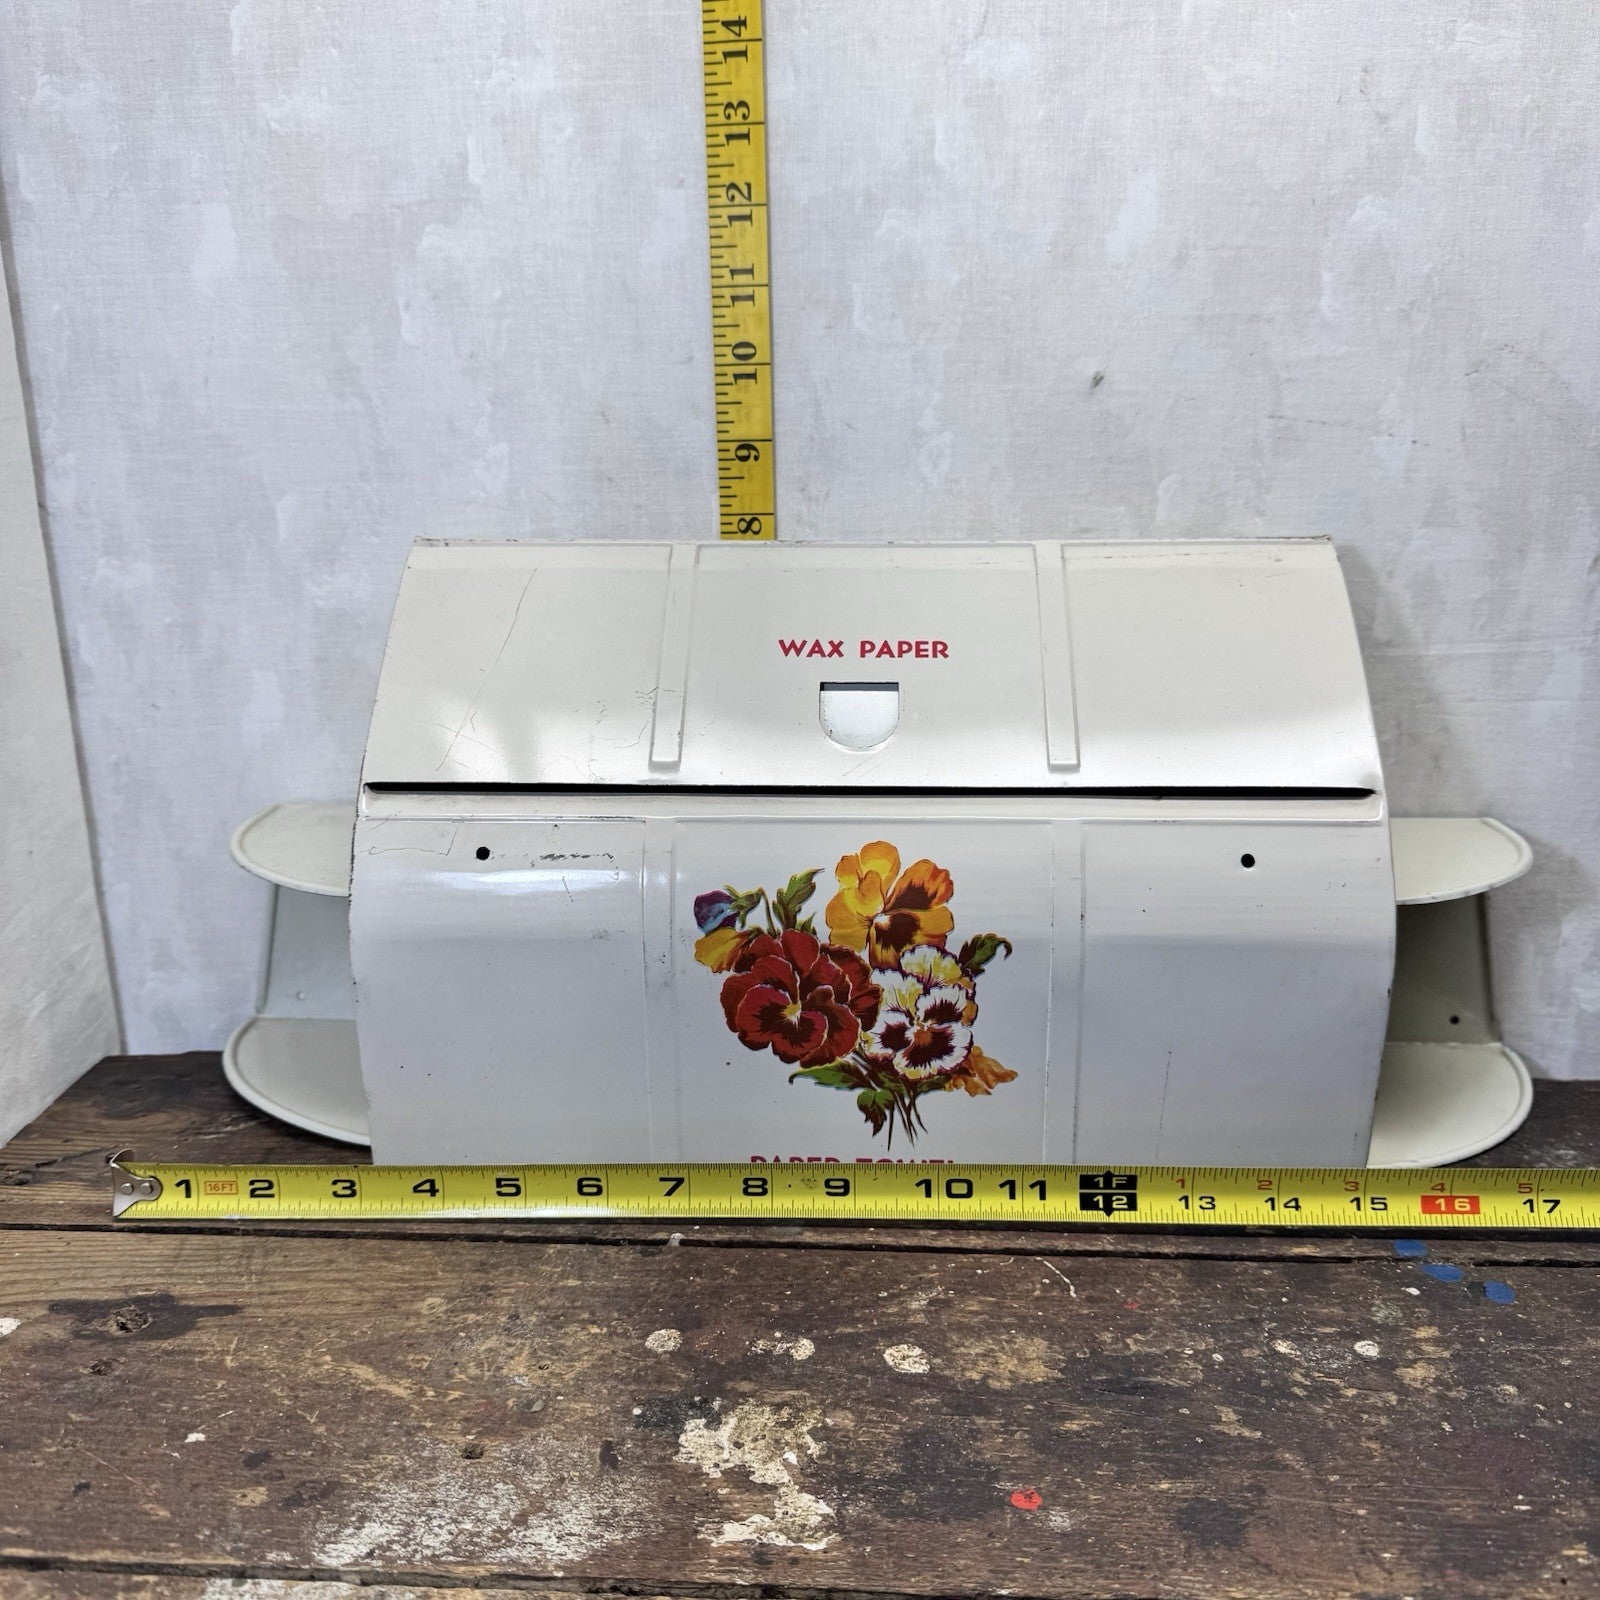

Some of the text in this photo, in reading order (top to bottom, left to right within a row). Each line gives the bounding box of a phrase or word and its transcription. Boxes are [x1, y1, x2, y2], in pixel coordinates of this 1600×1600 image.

[721, 15, 762, 535] 8 9 10 11 12 13 14
[778, 639, 950, 659] WAX PAPER
[174, 1179, 192, 1199] 1
[248, 1179, 276, 1198] 2
[331, 1179, 357, 1198] 3
[412, 1178, 440, 1198] 4
[495, 1177, 522, 1197] 5
[576, 1177, 603, 1196] 6
[658, 1177, 685, 1197] 7
[742, 1177, 769, 1197] 8
[824, 1178, 851, 1197] 9
[914, 1178, 974, 1199] 10
[998, 1179, 1047, 1201] 11
[1093, 1195, 1129, 1209] 12
[1178, 1195, 1217, 1211] 13
[1263, 1197, 1302, 1212] 14
[1349, 1197, 1389, 1212] 15
[1434, 1198, 1471, 1212] 16
[1522, 1199, 1561, 1214] 17
[1176, 1178, 1534, 1194] 1 2 3 4 5
